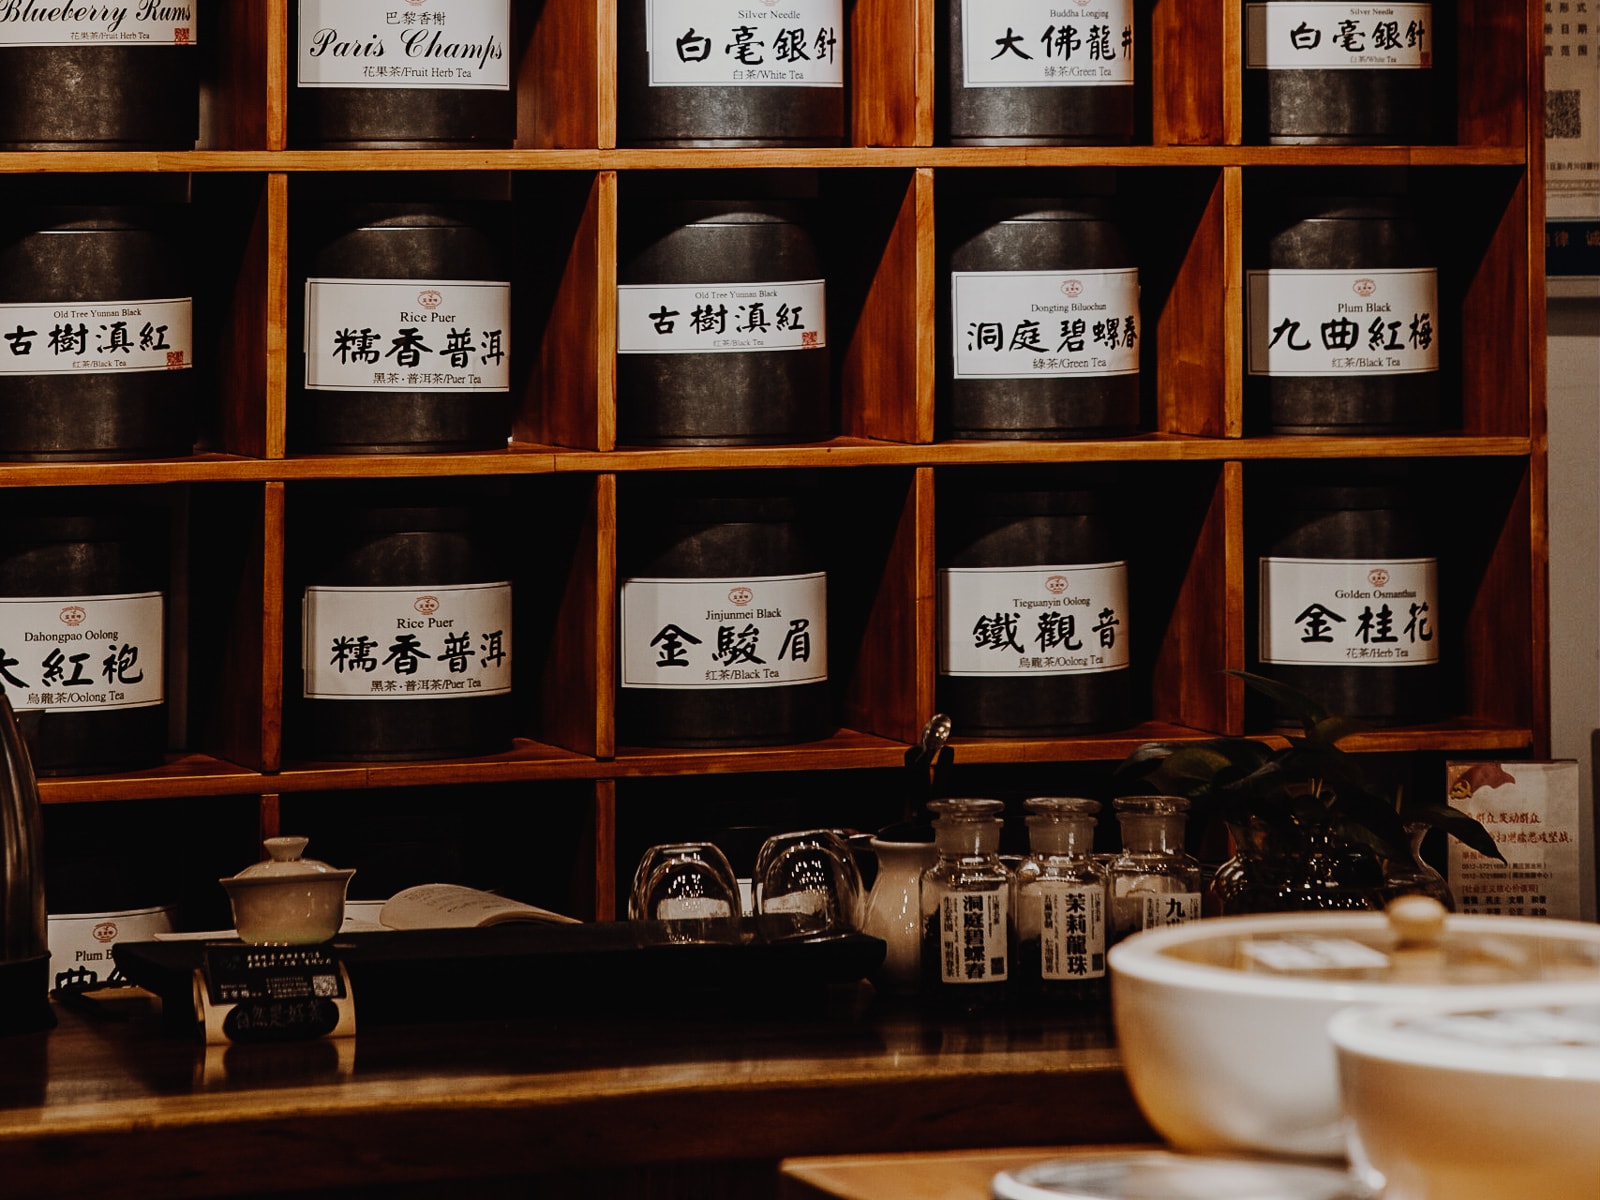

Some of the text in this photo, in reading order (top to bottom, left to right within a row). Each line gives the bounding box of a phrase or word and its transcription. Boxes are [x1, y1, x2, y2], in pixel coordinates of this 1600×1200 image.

[738, 10, 801, 20] Silver Needle
[1050, 9, 1079, 18] Buddha
[1350, 8, 1394, 16] Silver Needle
[1290, 19, 1426, 52] 白毫銀針
[309, 27, 503, 70] Paris Champs
[676, 25, 837, 66] 白毫銀針
[990, 24, 1133, 62] 大佛龍井
[362, 65, 472, 78] 花果茶/Fruit Herb Tea
[733, 69, 804, 80] 白茶/White Tea
[695, 291, 710, 300] Old
[712, 291, 728, 299] Tree
[759, 289, 778, 298] Black
[53, 308, 142, 319] Old Tree Yunnan Black
[1031, 303, 1069, 313] Dongting
[1338, 302, 1392, 313] Plum Black
[400, 311, 456, 324] Rice Puer
[649, 302, 805, 335] 古樹滇紅
[967, 315, 1138, 353] 洞庭碧螺春
[1268, 312, 1433, 351] 九曲紅梅
[4, 321, 171, 356] 古樹滇紅
[332, 327, 505, 368] 糯香普洱
[468, 373, 482, 384] Tea
[1335, 590, 1371, 599] Golden
[1012, 596, 1091, 609] Tieguanyin Oolong
[705, 607, 783, 622] Jinjunmei Black
[397, 617, 455, 629] Rice Puer
[1295, 601, 1433, 644] 金桂花
[24, 630, 119, 644] Dahongpao Oolong
[973, 607, 1120, 654] 鐵觀音
[650, 618, 811, 667] 金駿眉
[330, 630, 507, 675] 糯香普洱
[1394, 647, 1409, 658] Tea
[0, 643, 144, 689] 大紅袍
[1090, 655, 1104, 664] Tea
[467, 678, 482, 689] Tea
[109, 690, 125, 701] Tea
[963, 895, 986, 979] 洞庭碧螺春
[1065, 893, 1087, 975] 茉莉龍珠
[75, 950, 103, 962] Plum
